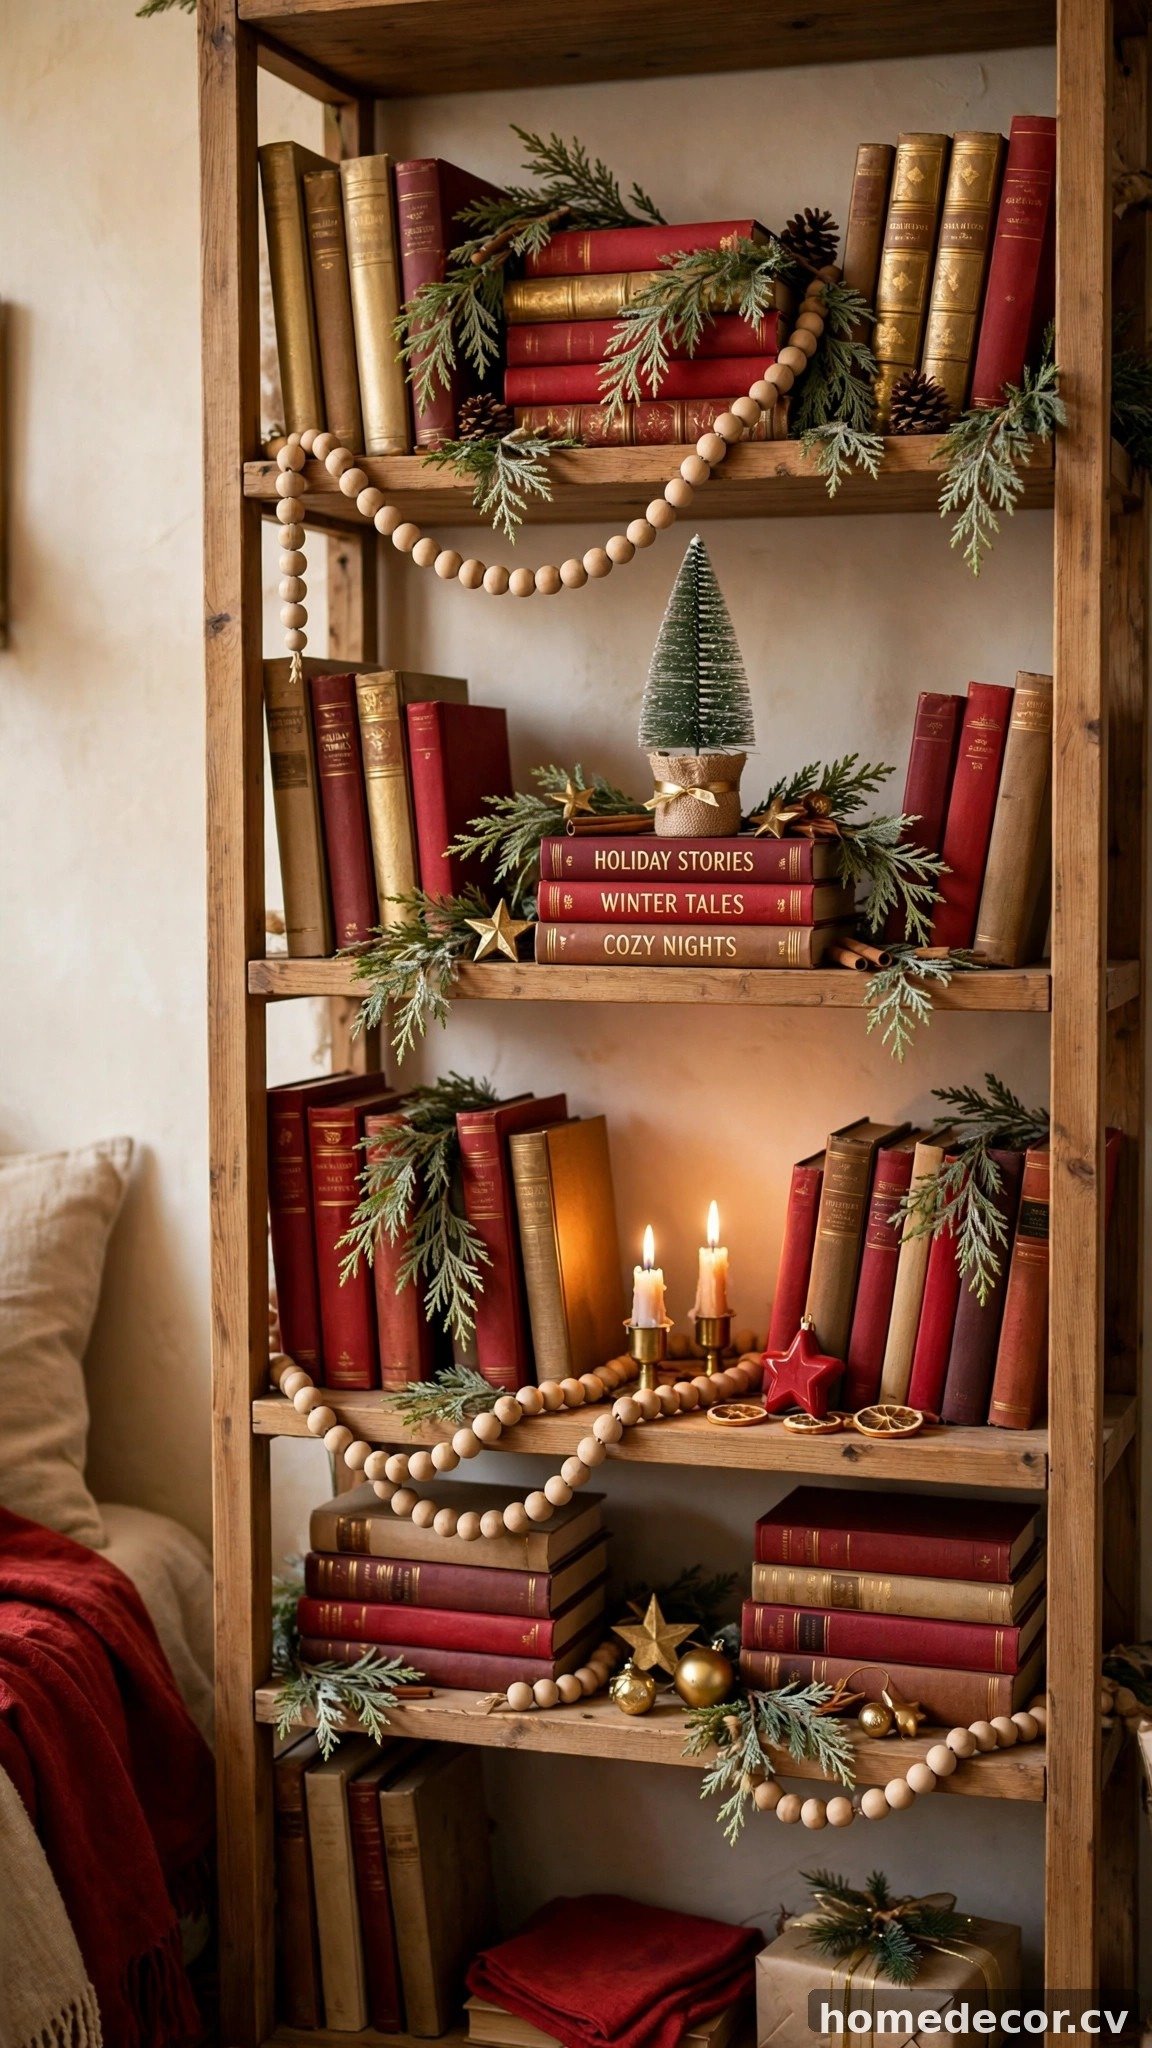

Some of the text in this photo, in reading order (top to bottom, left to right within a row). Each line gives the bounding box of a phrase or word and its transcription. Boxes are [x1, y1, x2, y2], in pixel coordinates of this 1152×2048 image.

[594, 850, 754, 872] HOLIDAY STORIES
[600, 892, 744, 915] WINTER TALES
[603, 934, 737, 957] COZY NIGHTS
